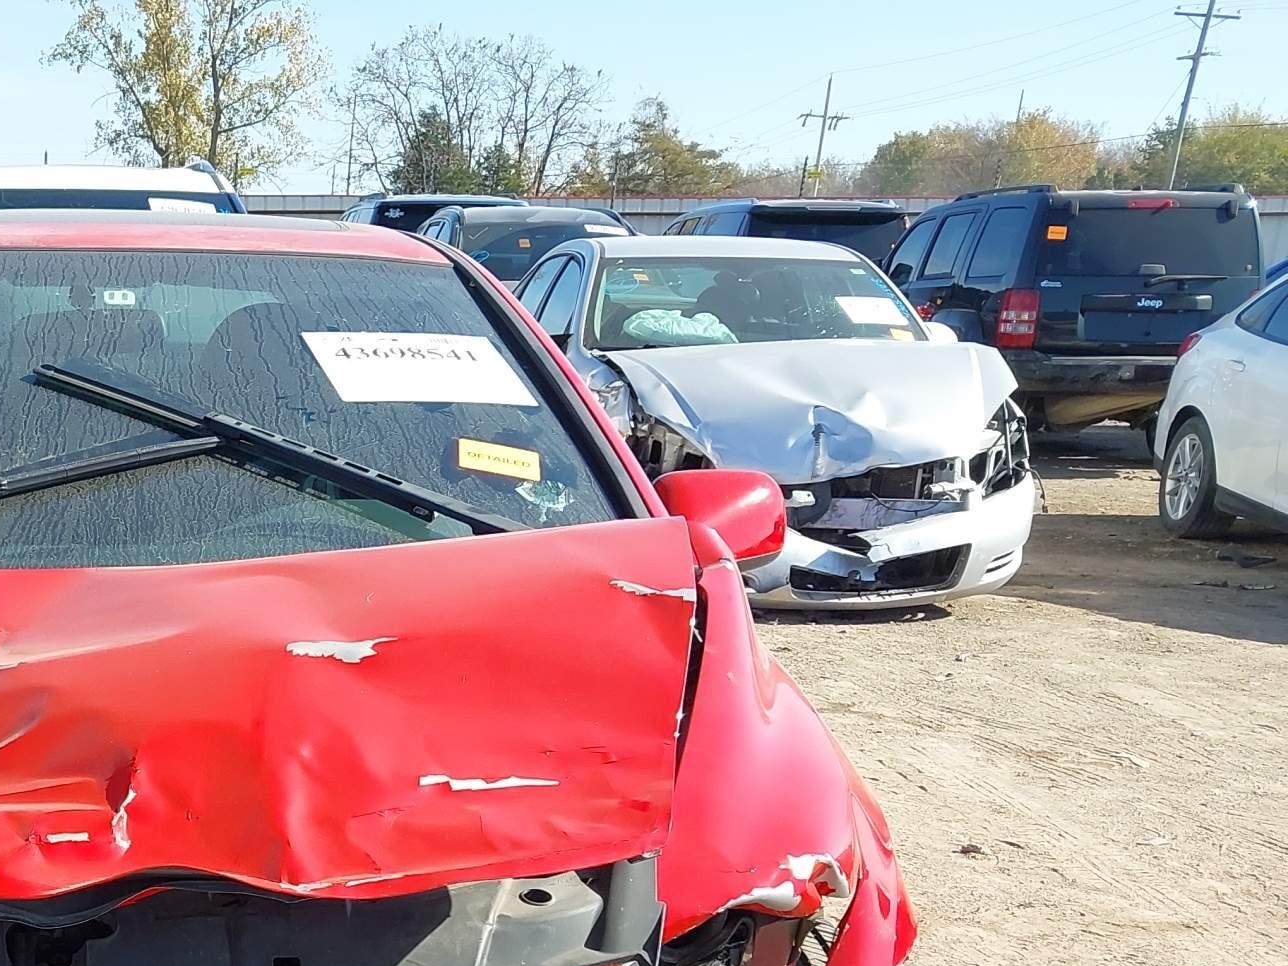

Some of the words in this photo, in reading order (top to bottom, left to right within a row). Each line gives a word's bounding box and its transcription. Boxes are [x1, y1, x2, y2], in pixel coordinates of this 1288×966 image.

[1137, 298, 1163, 309] Jeep
[334, 346, 478, 362] 43698541
[466, 451, 531, 468] DETAILED
